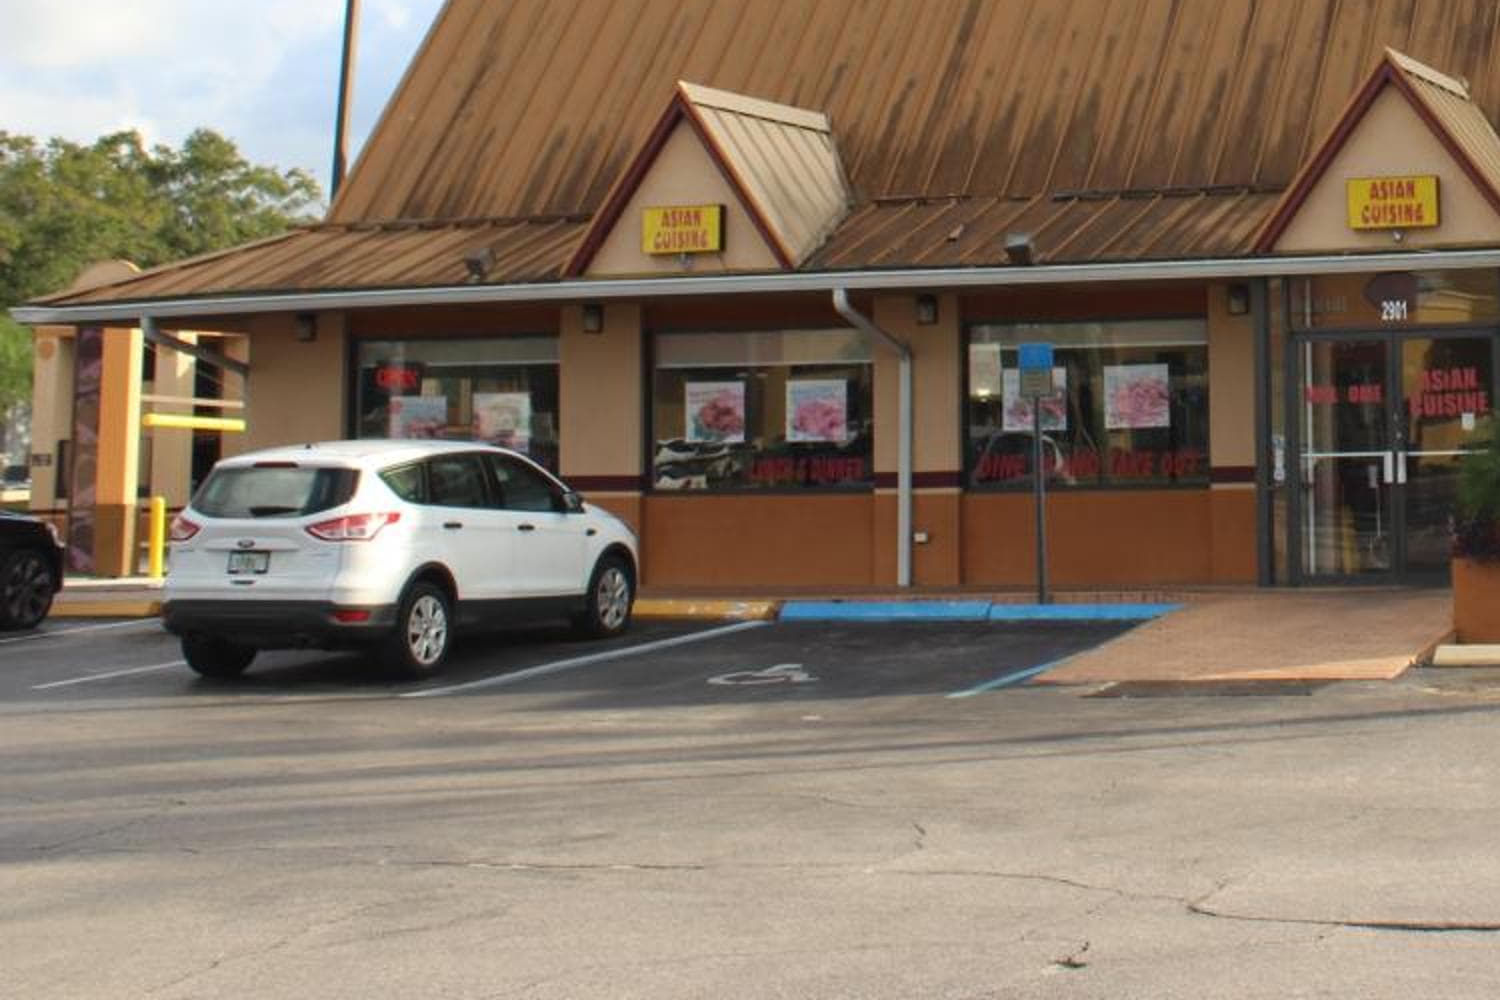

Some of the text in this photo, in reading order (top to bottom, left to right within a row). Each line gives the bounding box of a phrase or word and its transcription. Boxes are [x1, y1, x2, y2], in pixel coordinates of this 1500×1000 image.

[1368, 181, 1415, 200] ASIAN
[660, 210, 704, 229] ASIAN
[1361, 203, 1424, 224] CUISINE
[654, 231, 710, 250] CUISINE
[1379, 300, 1408, 321] 2901
[1418, 366, 1479, 392] ASIAN
[1409, 391, 1489, 417] CUISINE
